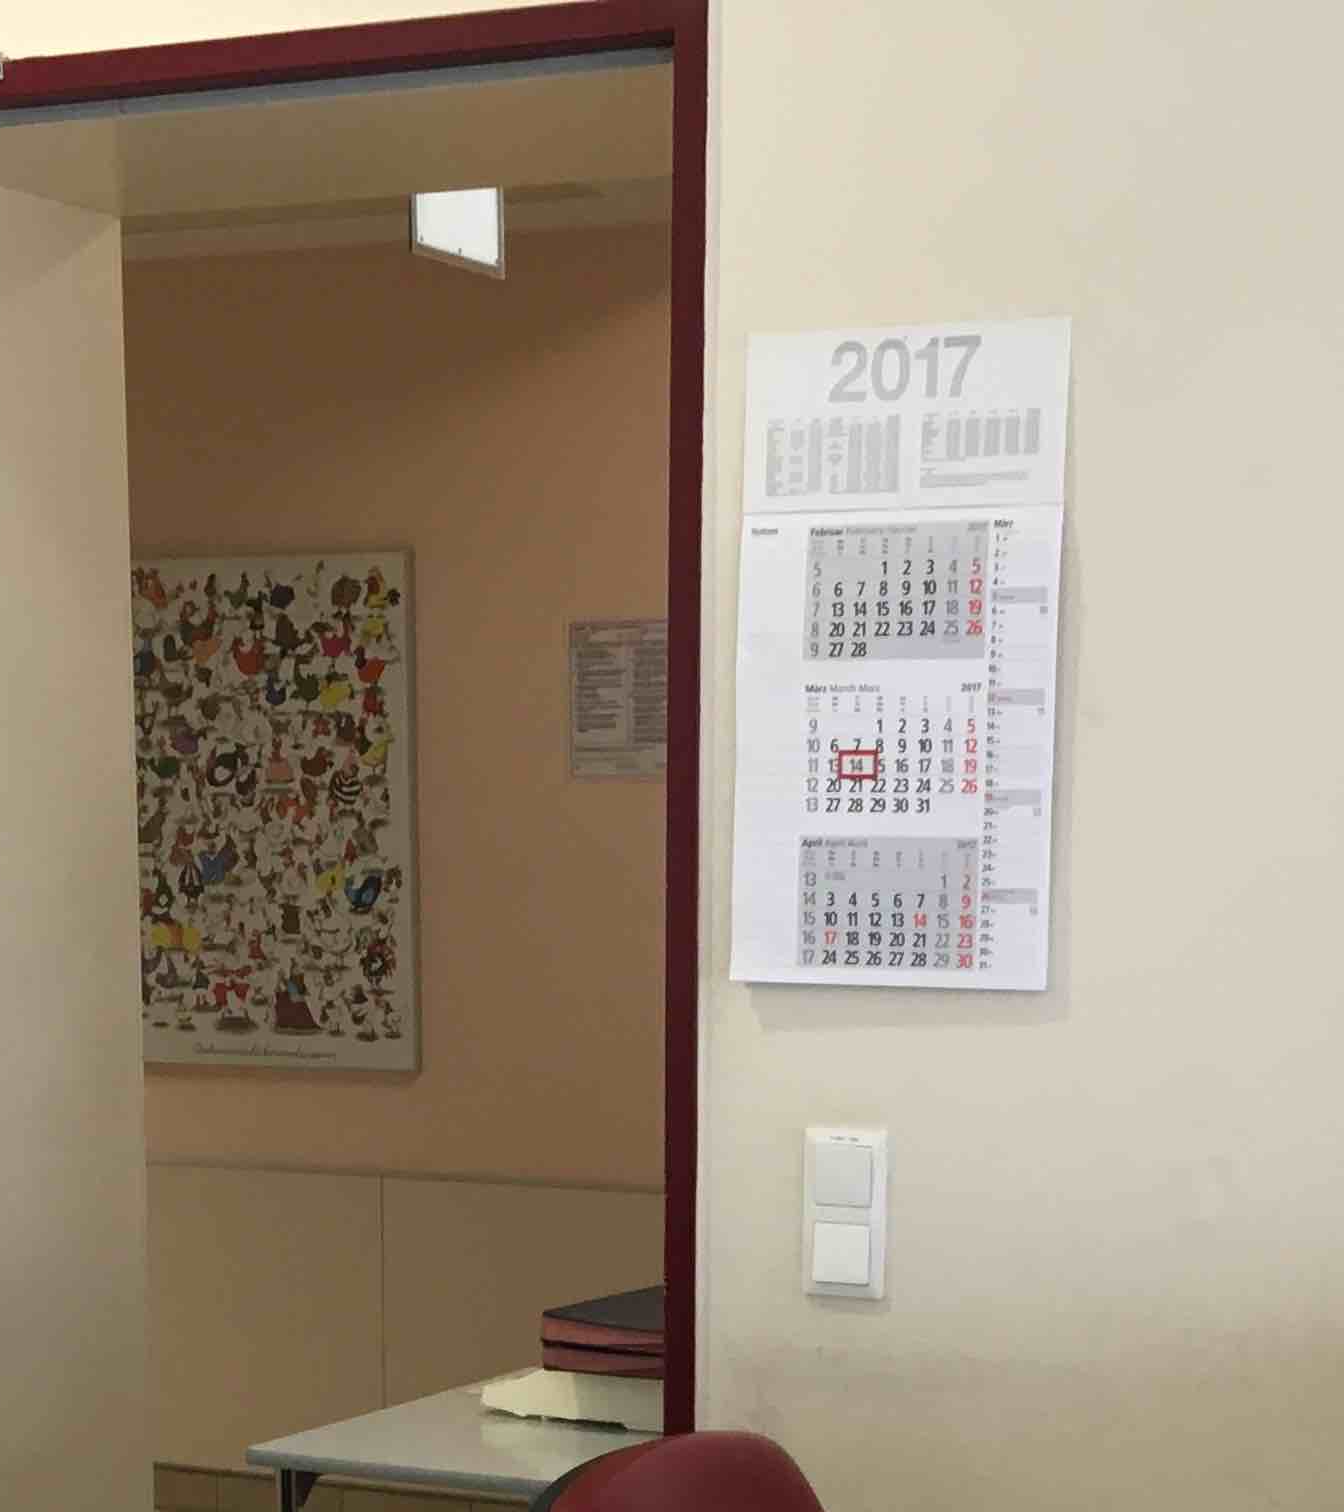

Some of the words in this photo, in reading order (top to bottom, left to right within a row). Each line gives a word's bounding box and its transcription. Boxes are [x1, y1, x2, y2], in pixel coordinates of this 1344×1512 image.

[827, 334, 982, 403] 2017
[810, 527, 844, 537] Februar
[881, 560, 888, 576] 1
[902, 559, 912, 576] 2
[926, 558, 935, 576] 3
[971, 557, 982, 576] 5
[833, 581, 844, 598] 6
[857, 580, 866, 597] 7
[878, 580, 889, 597] 8
[901, 580, 912, 596] 9
[922, 579, 937, 596] 10
[968, 577, 984, 596] 12
[831, 601, 845, 618] 13
[853, 601, 868, 617] 14
[875, 600, 890, 617] 15
[899, 599, 913, 617] 16
[922, 599, 936, 617] 17
[967, 599, 983, 616] 19
[828, 621, 846, 638] 20
[852, 621, 867, 638] 21
[873, 620, 891, 638] 22
[896, 620, 914, 637] 23
[919, 620, 936, 637] 24
[965, 618, 983, 637] 26
[828, 641, 845, 658] 27
[850, 641, 868, 658] 28
[805, 684, 827, 693] März
[960, 682, 982, 693] 2017
[876, 718, 883, 734] 1
[898, 717, 907, 734] 2
[921, 717, 930, 735] 3
[967, 717, 976, 735] 5
[829, 738, 840, 752] 6
[897, 738, 907, 754] 9
[917, 737, 933, 754] 10
[964, 737, 978, 755] 12
[849, 758, 864, 774] 14
[894, 757, 910, 774] 16
[918, 757, 932, 774] 17
[963, 758, 978, 775] 19
[826, 777, 842, 793] 20
[848, 777, 863, 793] 21
[870, 777, 886, 794] 22
[892, 777, 910, 794] 23
[915, 777, 932, 794] 24
[961, 777, 979, 795] 26
[825, 797, 841, 813] 27
[847, 797, 864, 814] 28
[869, 797, 887, 814] 29
[892, 797, 910, 814] 30
[916, 797, 931, 814] 31
[801, 838, 823, 849] April
[826, 890, 836, 907] 3
[848, 891, 858, 907] 4
[871, 891, 880, 908] 5
[892, 892, 903, 909] 6
[917, 893, 925, 909] 7
[960, 893, 972, 911] 9
[823, 910, 838, 927] 10
[847, 911, 859, 927] 11
[868, 911, 883, 928] 12
[890, 912, 905, 928] 13
